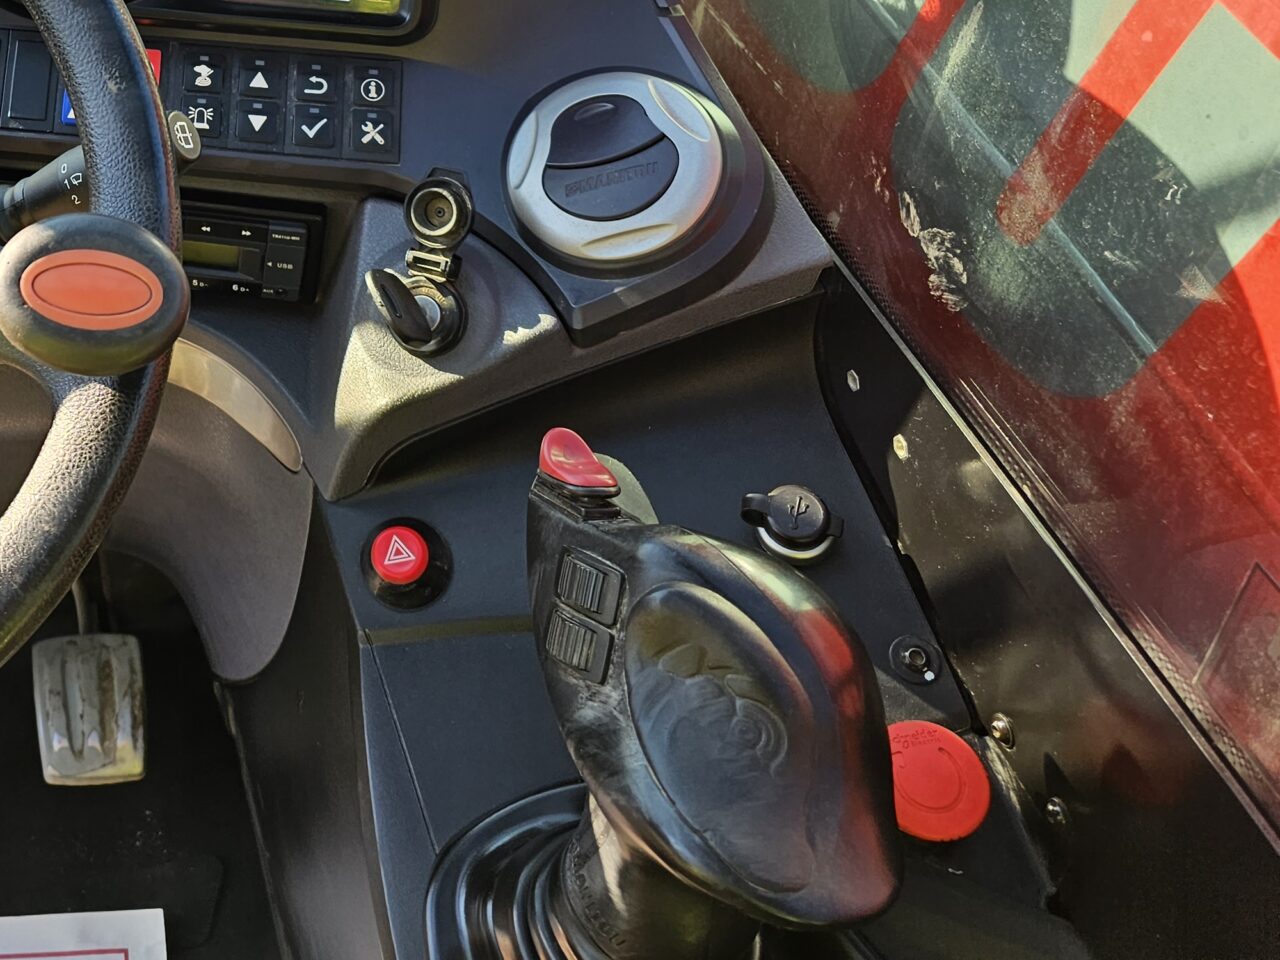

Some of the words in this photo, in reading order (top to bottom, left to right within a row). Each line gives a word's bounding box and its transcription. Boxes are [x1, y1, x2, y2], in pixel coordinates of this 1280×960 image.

[71, 194, 81, 205] 2
[276, 262, 293, 270] USB
[192, 279, 198, 287] 5
[232, 284, 239, 292] 6
